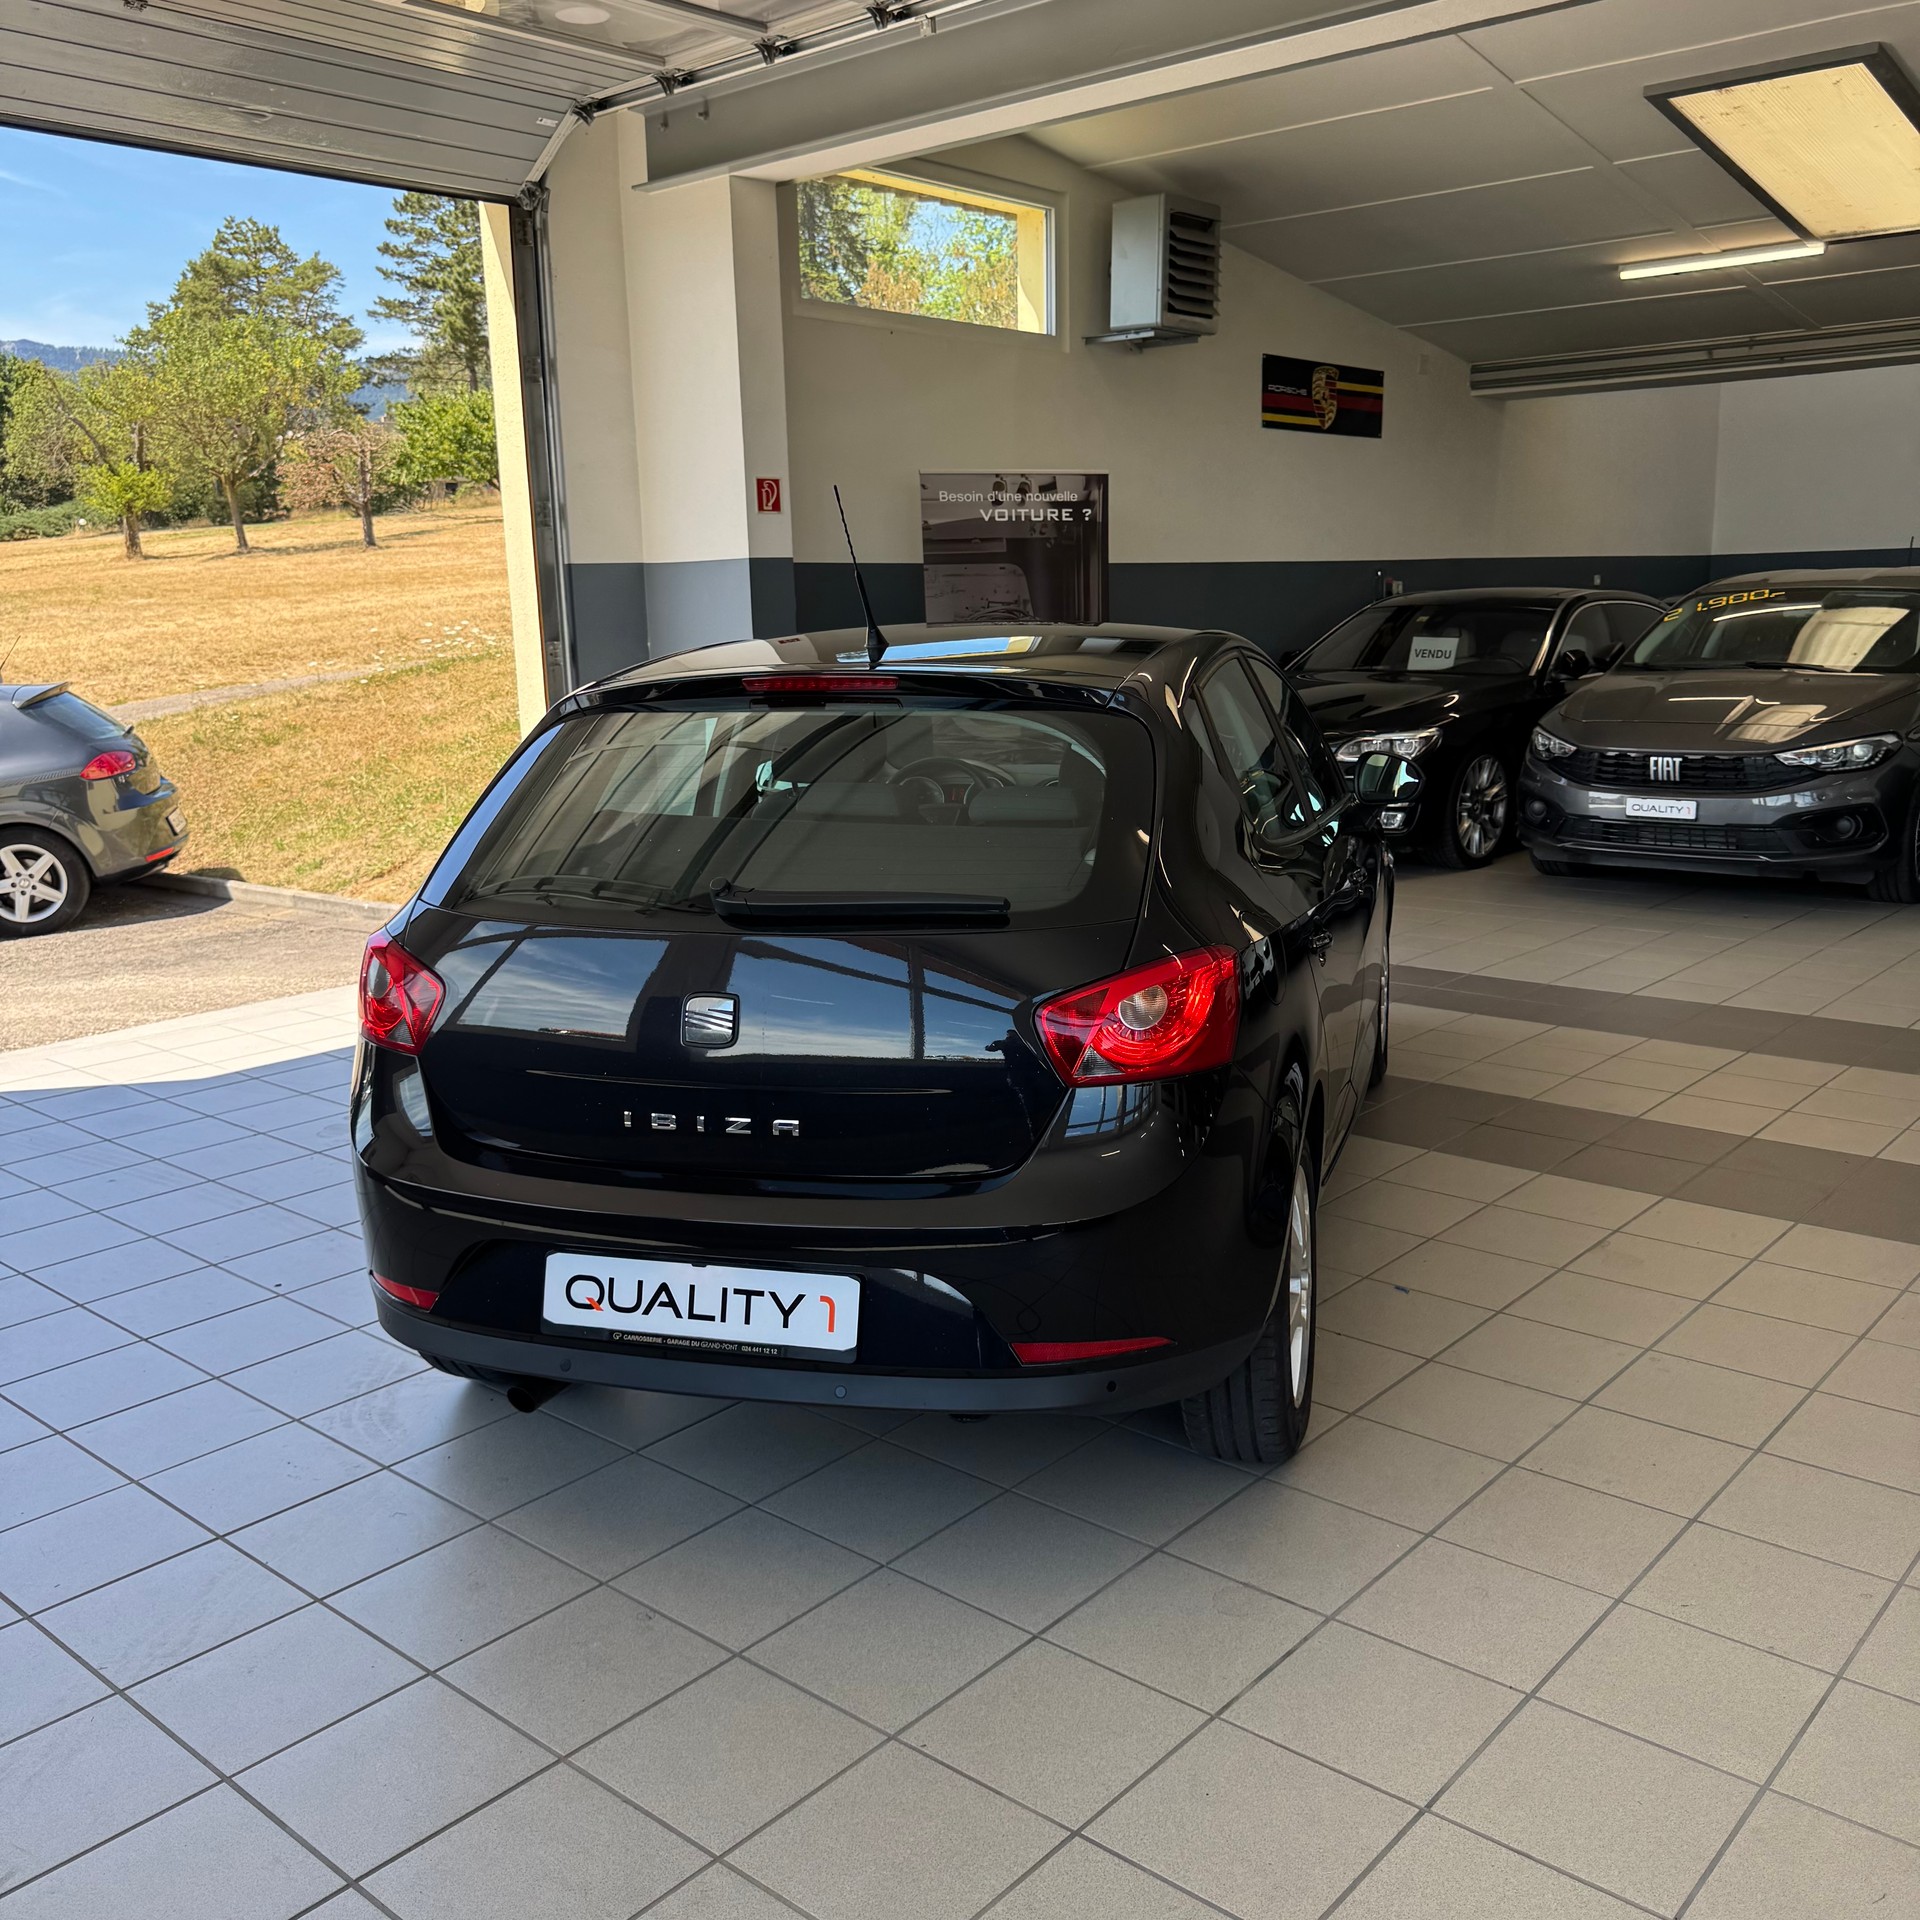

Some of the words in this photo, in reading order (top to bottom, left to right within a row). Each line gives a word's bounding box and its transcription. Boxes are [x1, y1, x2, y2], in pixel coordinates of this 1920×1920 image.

[938, 490, 984, 502] Besoin
[987, 490, 1022, 502] d'une
[1024, 490, 1079, 502] nouvelle
[980, 509, 1073, 521] VOITURE
[1082, 509, 1092, 521] ?
[1414, 648, 1452, 659] VENDU
[1650, 756, 1683, 782] FIAT
[1631, 803, 1684, 815] QUALITY
[623, 1110, 800, 1137] IBIZA
[565, 1274, 806, 1330] QUALITY
[623, 1334, 662, 1343] CARROSSERIE
[667, 1338, 690, 1346] GARAGE
